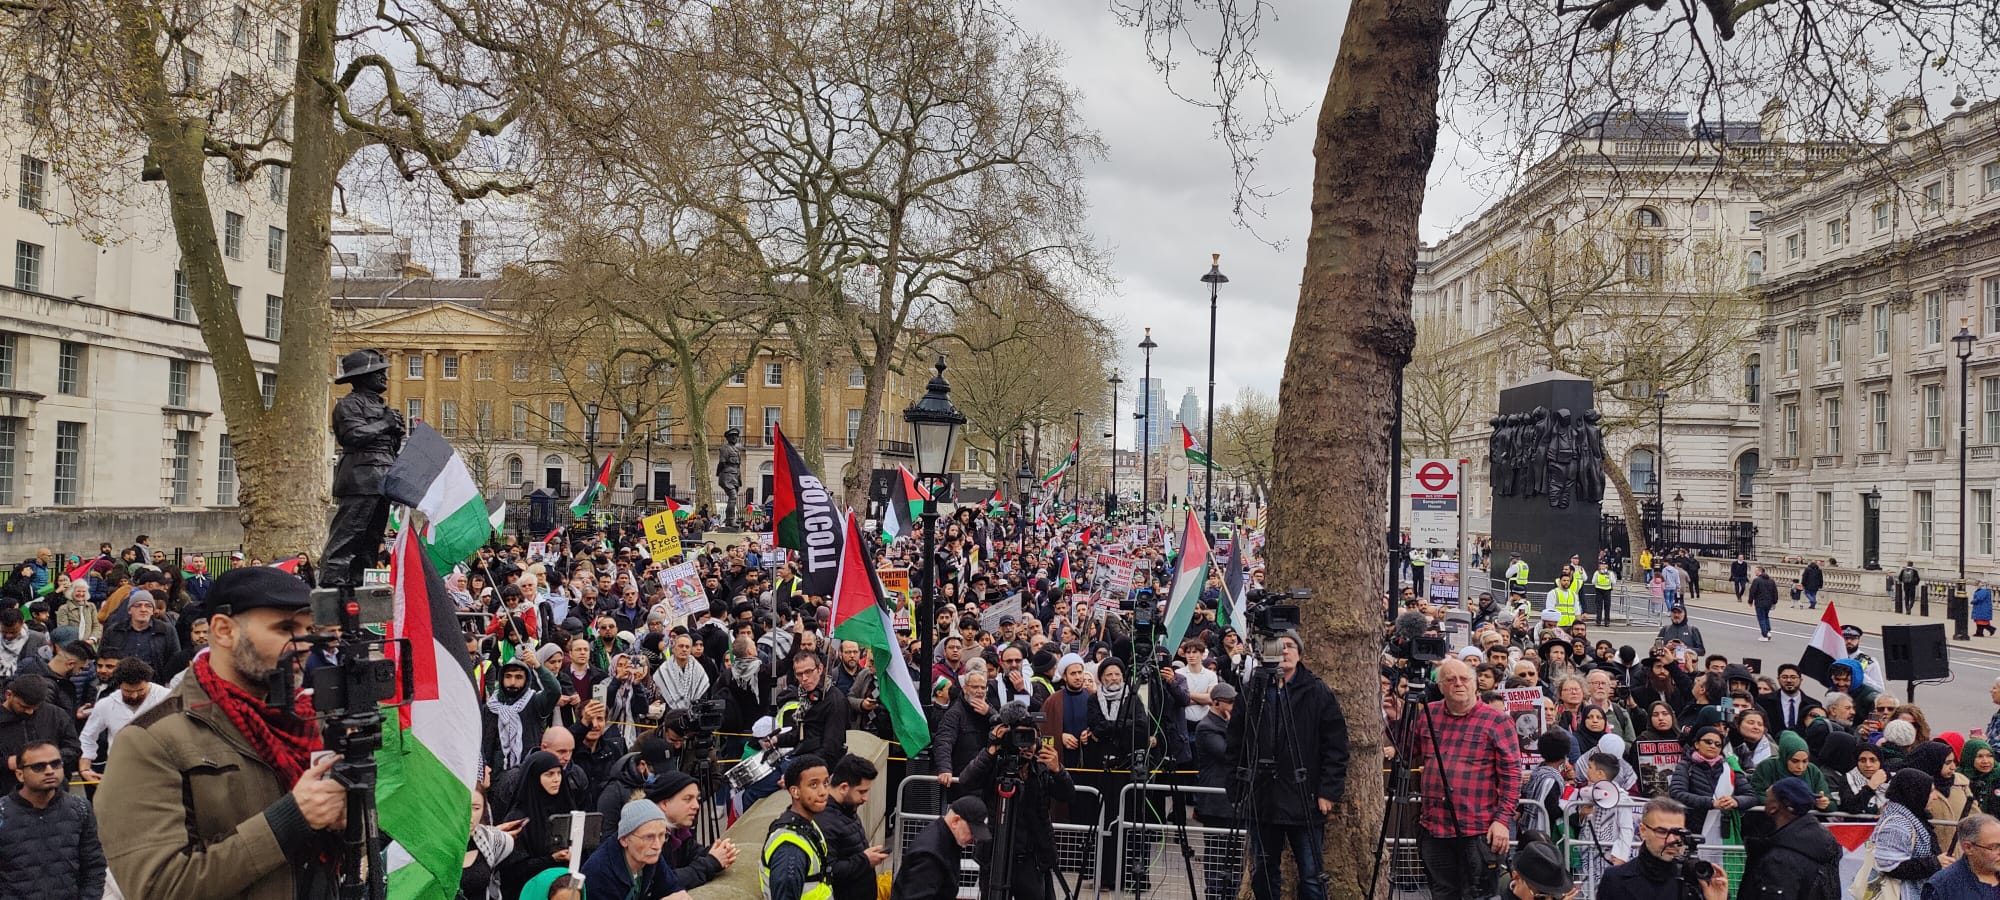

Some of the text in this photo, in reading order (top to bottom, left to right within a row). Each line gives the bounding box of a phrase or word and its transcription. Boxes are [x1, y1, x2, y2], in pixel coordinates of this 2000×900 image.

[650, 535, 677, 550] Free
[652, 543, 679, 555] Palestine
[662, 568, 695, 584] PALESTINE
[1431, 590, 1459, 598] PALESTIN
[1508, 690, 1540, 700] DEMAND
[1640, 743, 1681, 753] END GENO
[1654, 755, 1662, 764] IN
